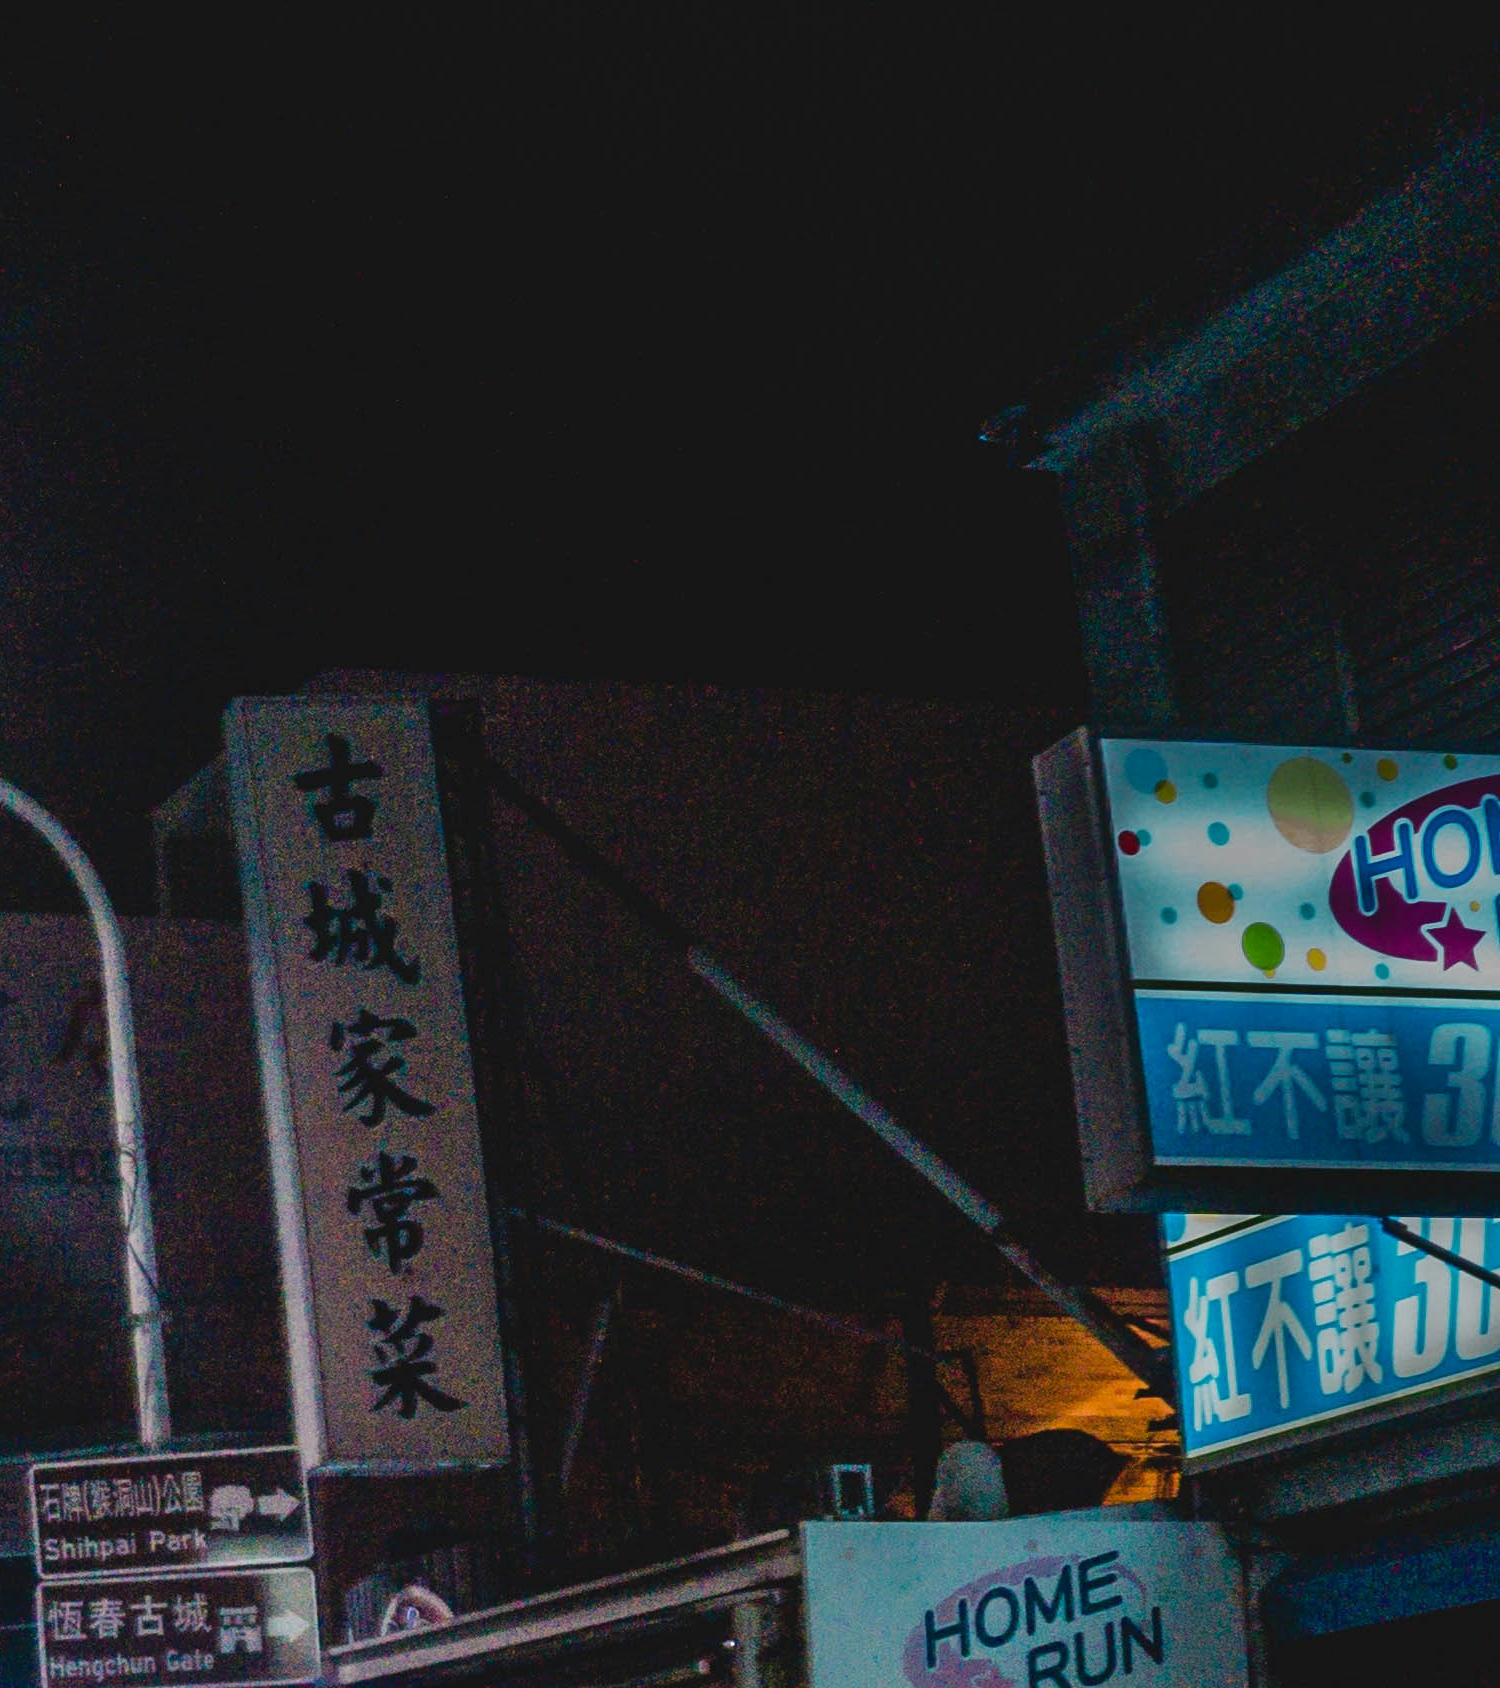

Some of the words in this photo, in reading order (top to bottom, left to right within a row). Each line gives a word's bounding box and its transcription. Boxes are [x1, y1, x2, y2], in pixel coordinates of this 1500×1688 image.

[1354, 794, 1500, 916] HO
[293, 733, 467, 1420] 古城家常菜
[1166, 1022, 1412, 1146] 紅不讓
[1423, 1022, 1500, 1148] 3
[1184, 1222, 1384, 1432] 紅不讓
[43, 1532, 137, 1562] Shihpai
[148, 1527, 208, 1552] Park
[49, 1591, 214, 1642] 恆春古城
[49, 1654, 157, 1684] Hengchun
[165, 1650, 216, 1672] Gate
[924, 1549, 1125, 1670] HOME
